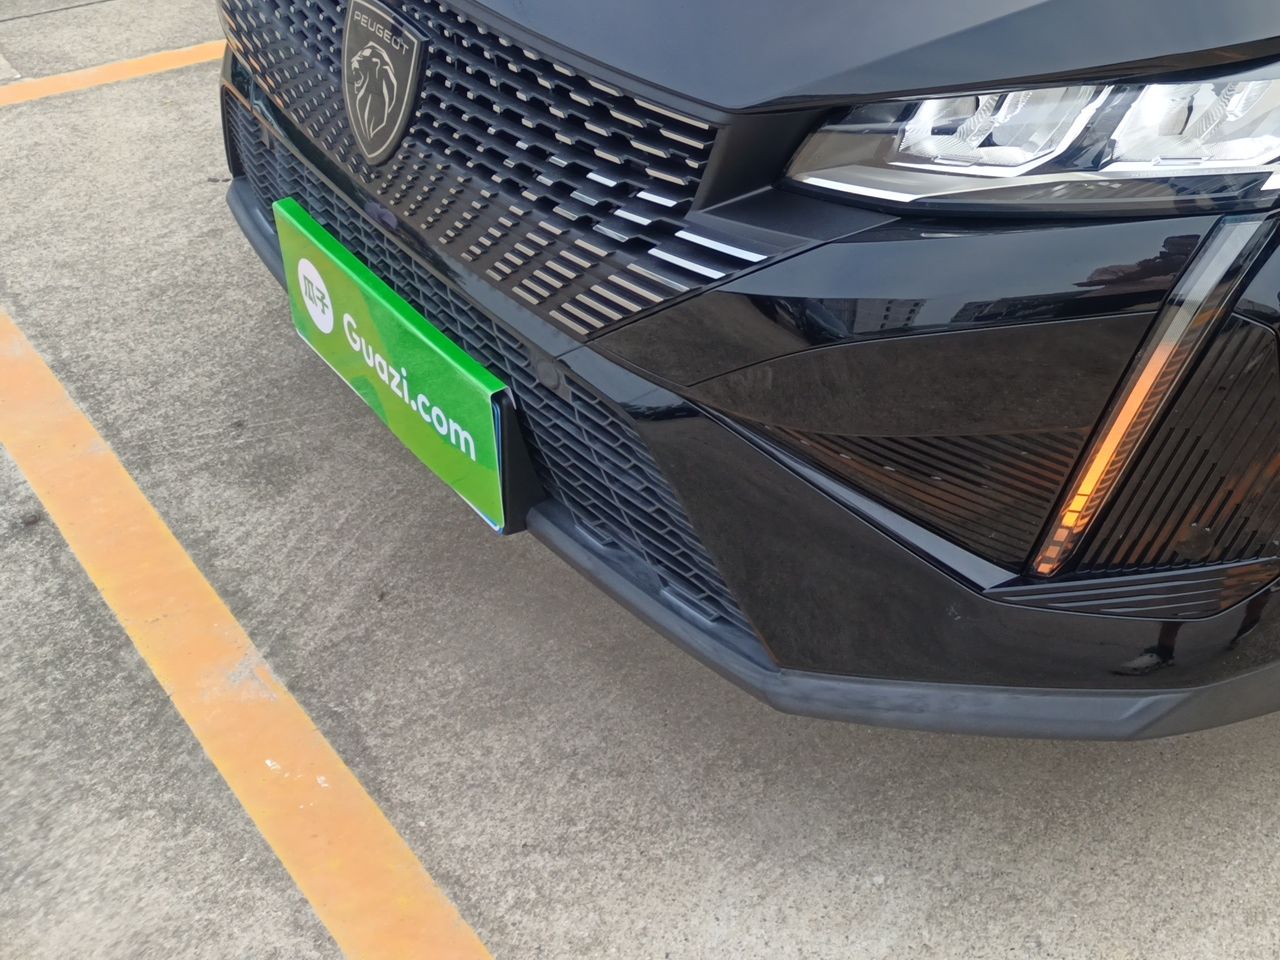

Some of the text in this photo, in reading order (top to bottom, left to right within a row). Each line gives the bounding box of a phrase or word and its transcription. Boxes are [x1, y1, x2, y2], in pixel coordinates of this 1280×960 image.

[353, 10, 409, 55] PEUGEOT
[303, 275, 329, 315] 瓜子
[343, 313, 476, 461] Guazi.com
